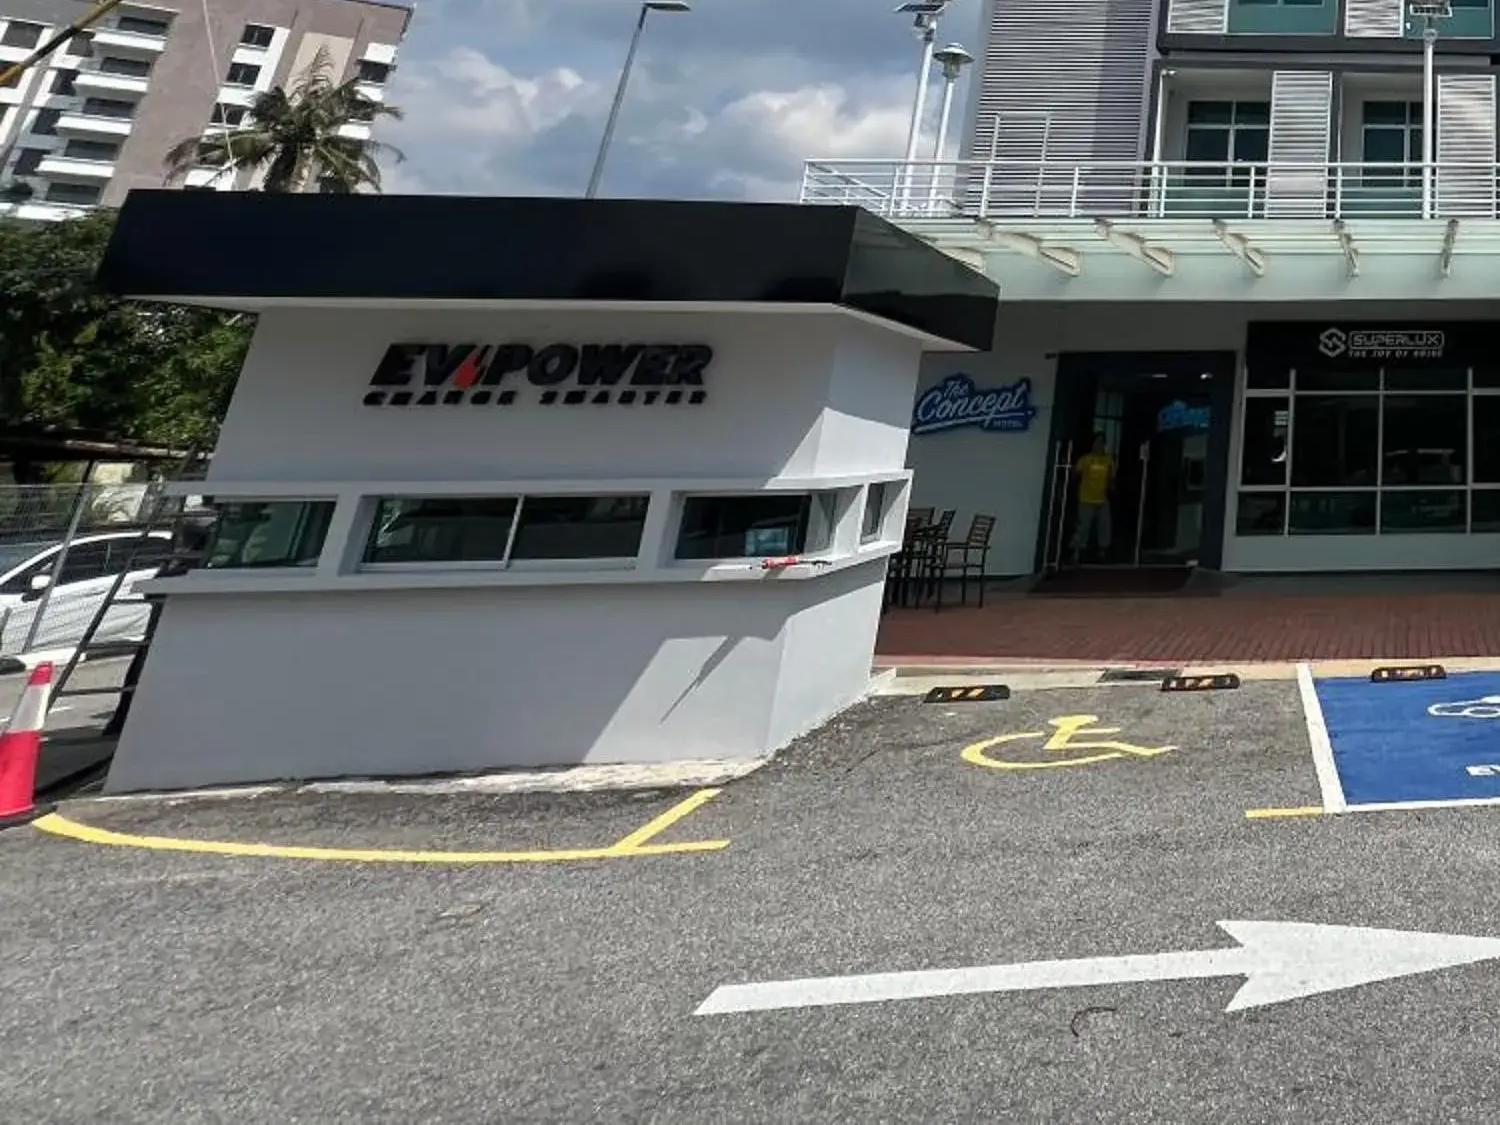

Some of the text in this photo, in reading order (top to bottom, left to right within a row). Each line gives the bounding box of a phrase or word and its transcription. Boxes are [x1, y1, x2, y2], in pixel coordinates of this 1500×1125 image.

[1353, 334, 1440, 346] SUPERLUX
[944, 380, 970, 397] The
[918, 381, 1028, 429] Concept
